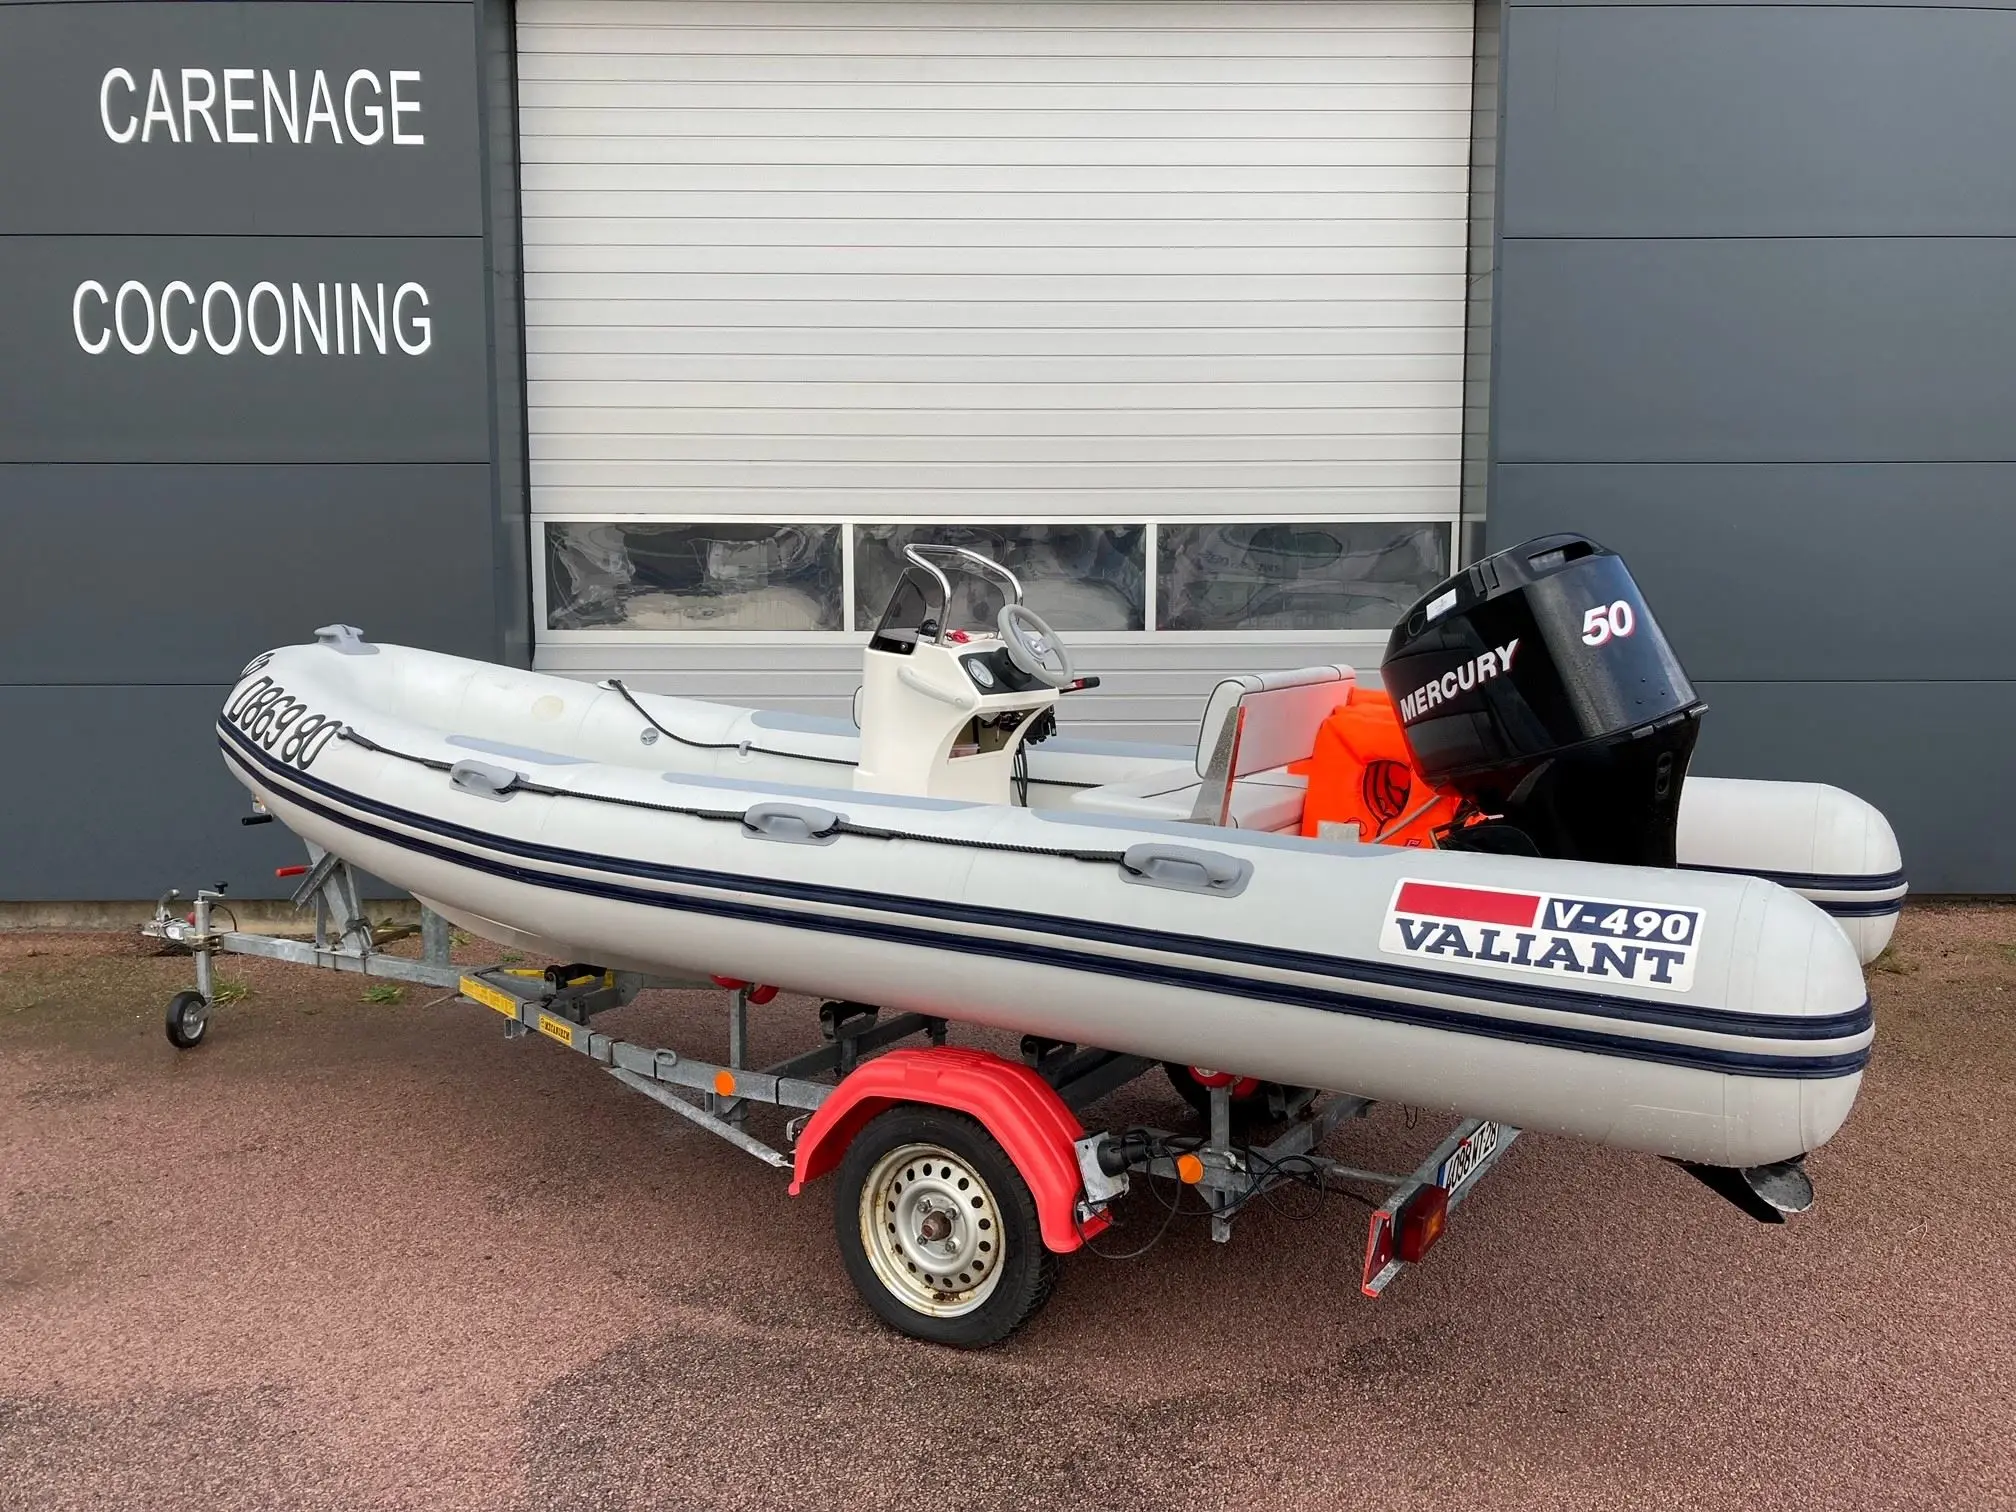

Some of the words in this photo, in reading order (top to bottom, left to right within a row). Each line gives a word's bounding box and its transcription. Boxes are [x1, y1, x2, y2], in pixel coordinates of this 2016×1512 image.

[100, 67, 424, 145] CARENAGE
[73, 279, 432, 356] COCOONING
[1582, 600, 1636, 645] 50
[1400, 638, 1519, 723] MERCURY
[1396, 917, 1685, 984] VALIANT
[1553, 901, 1690, 942] V-490
